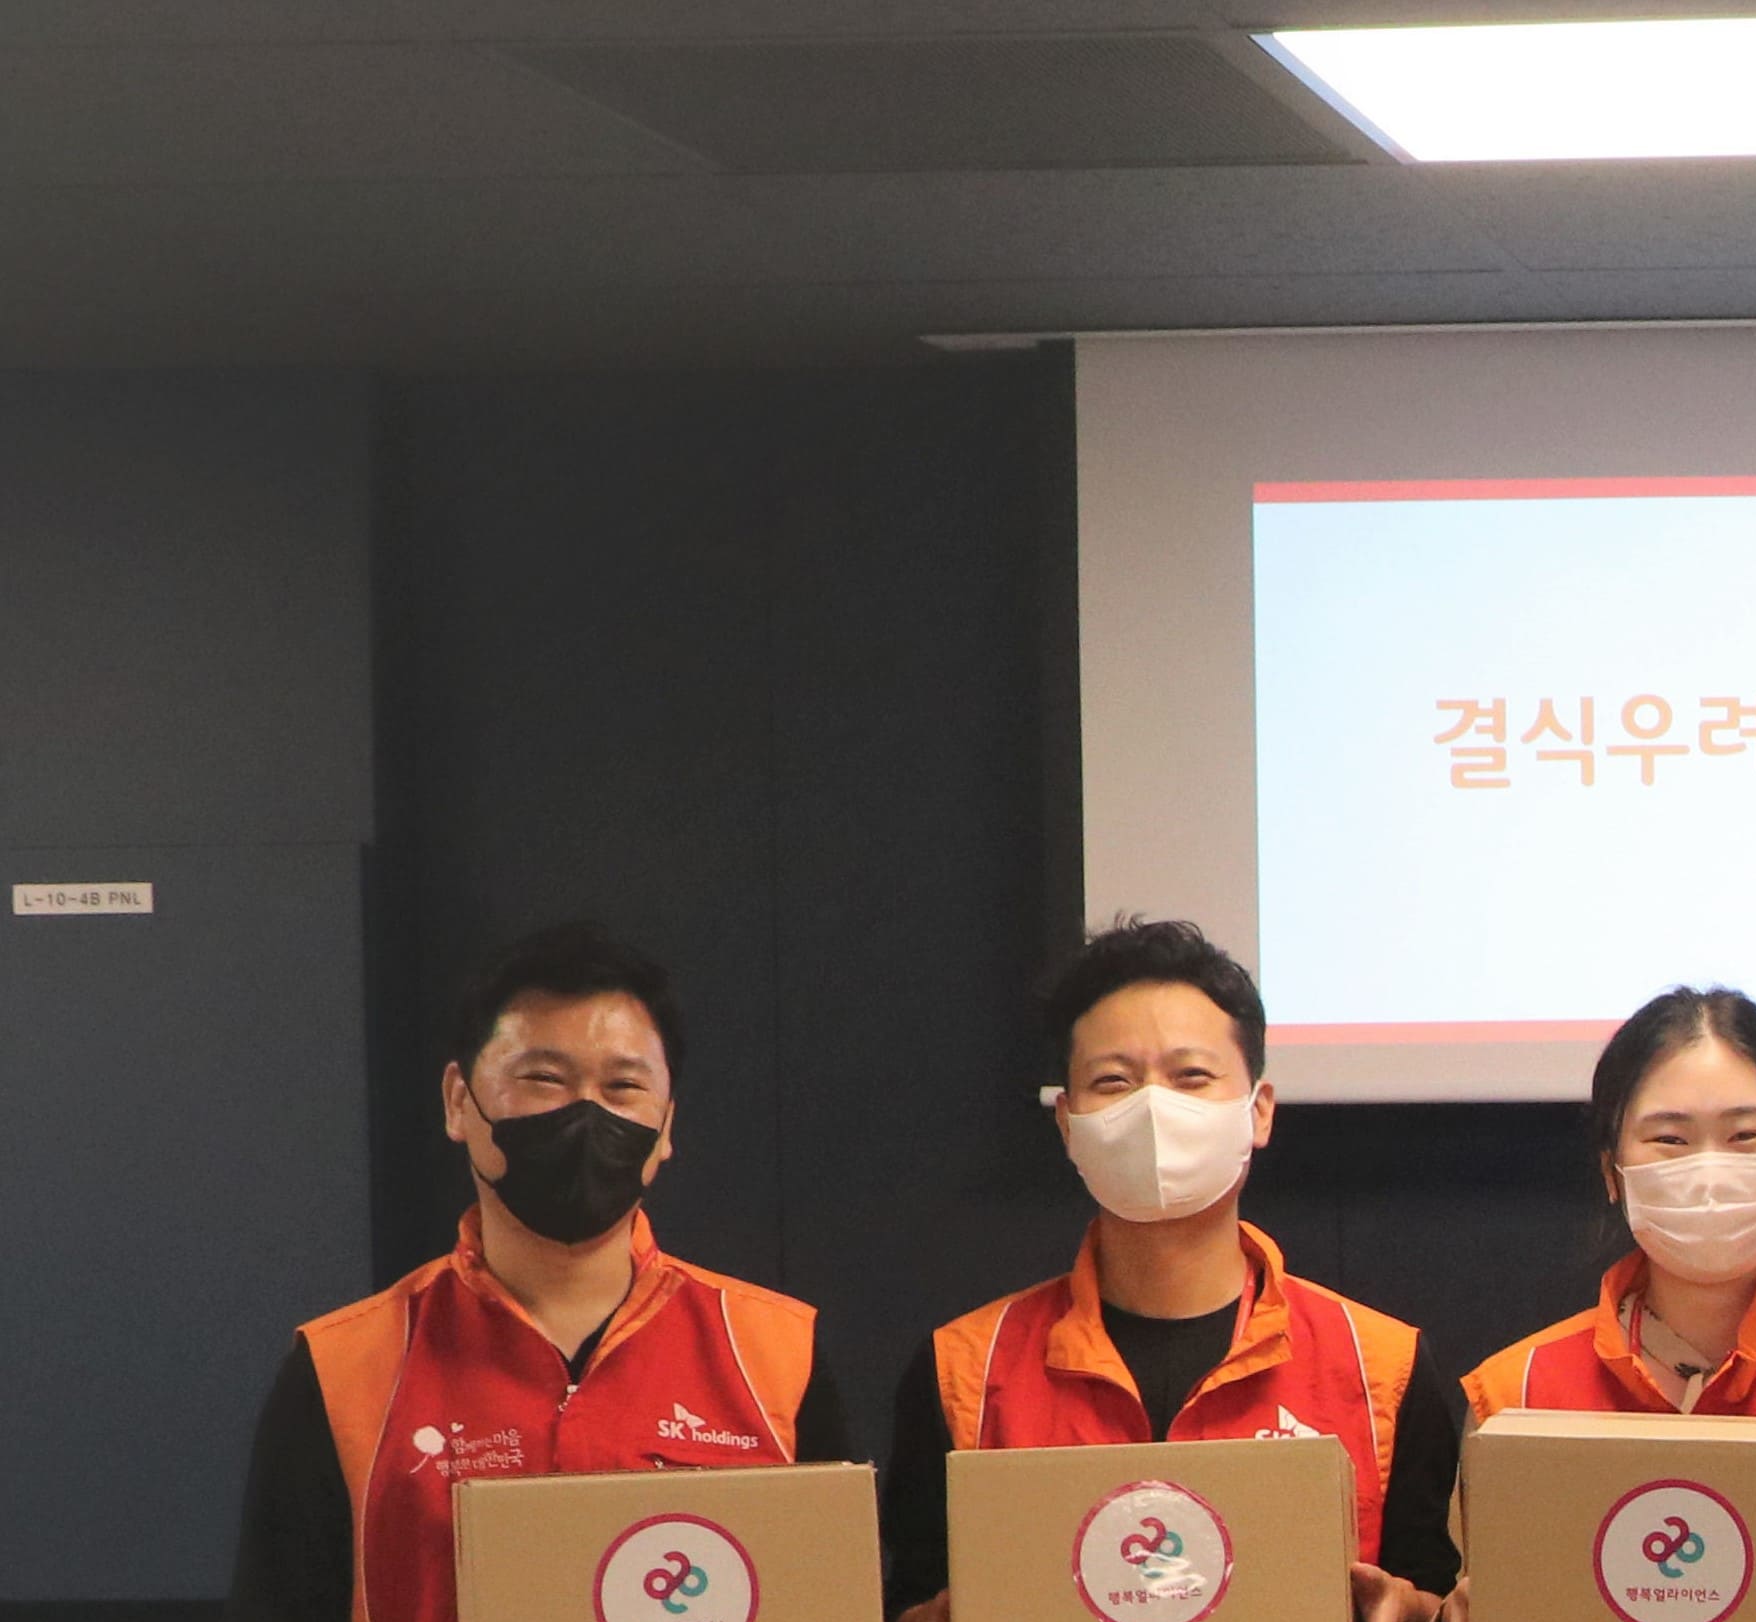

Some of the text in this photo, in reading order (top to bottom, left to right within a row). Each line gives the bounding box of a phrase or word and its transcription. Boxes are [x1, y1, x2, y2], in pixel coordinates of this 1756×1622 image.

[108, 891, 142, 906] PNL
[657, 1419, 760, 1450] SK holdings
[1626, 1588, 1719, 1602] 행복얼라이언스
